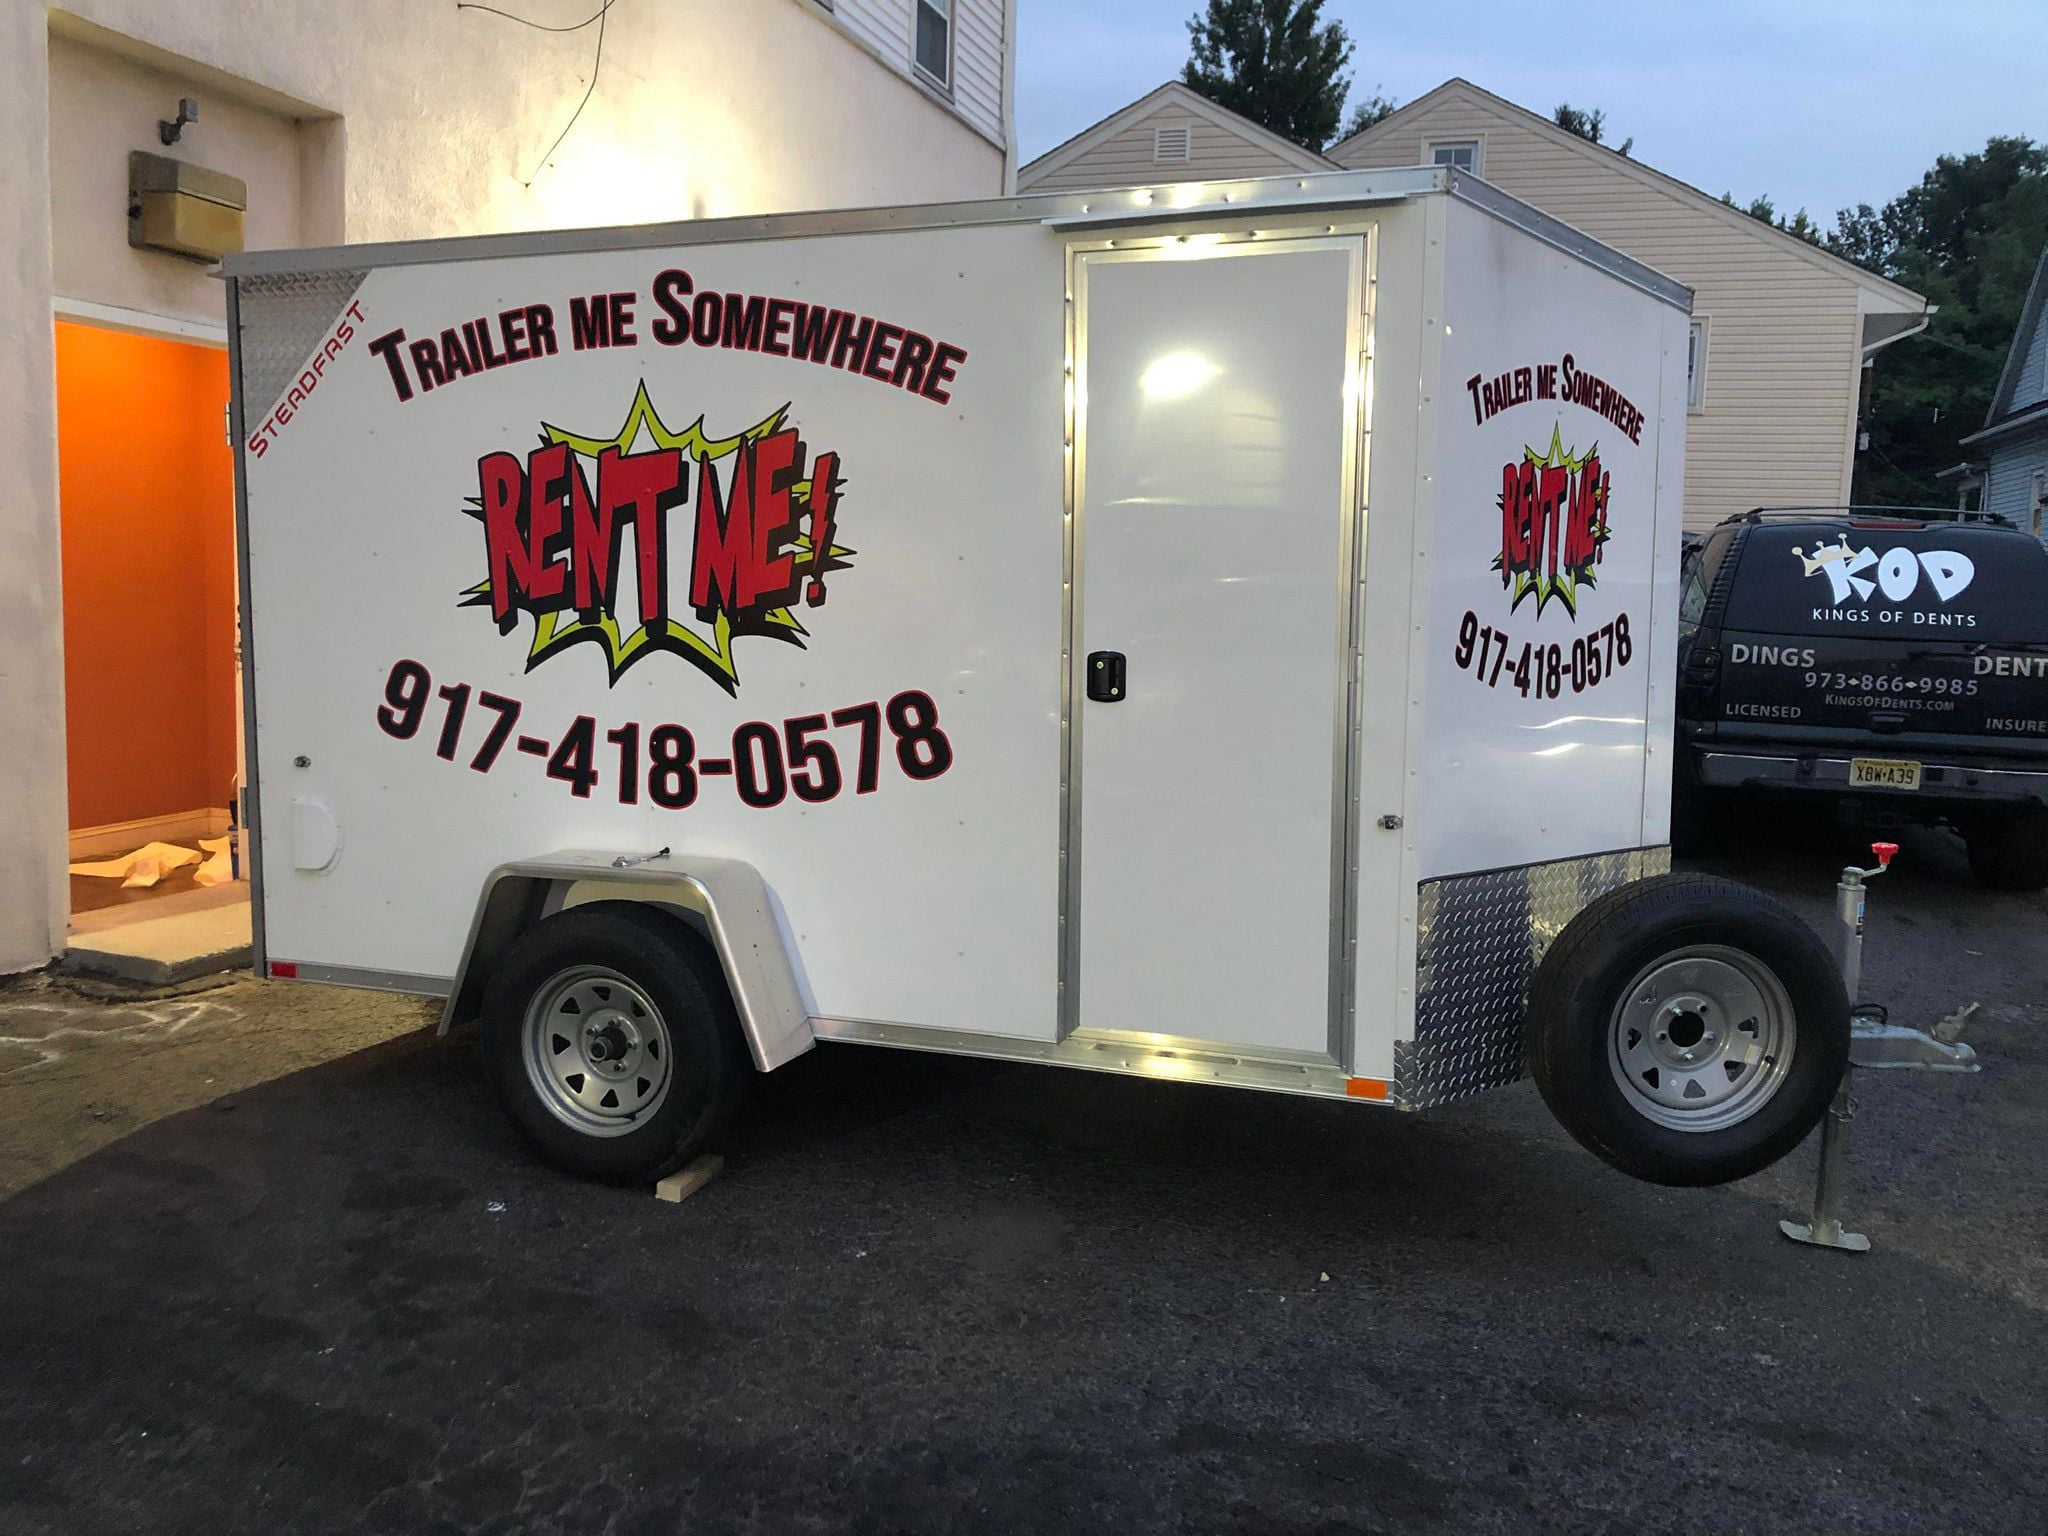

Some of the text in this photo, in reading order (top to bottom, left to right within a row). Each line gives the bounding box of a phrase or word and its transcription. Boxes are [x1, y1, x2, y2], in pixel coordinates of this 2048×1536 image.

[248, 299, 365, 459] STEADFAST
[368, 269, 968, 405] TRAILER ME SOMEWHERE
[1466, 353, 1646, 447] TRAILER ME SOMEWHERE
[477, 441, 690, 637] RENT
[1502, 457, 1569, 590] RENT
[1811, 544, 1976, 606] KOD
[1812, 608, 1977, 627] KINGS OF DENTS
[1454, 610, 1633, 701] 917-418-0578
[1731, 643, 1816, 669] DINGS
[376, 659, 954, 809] 917-418-0578
[1725, 703, 1802, 719] LICENSED
